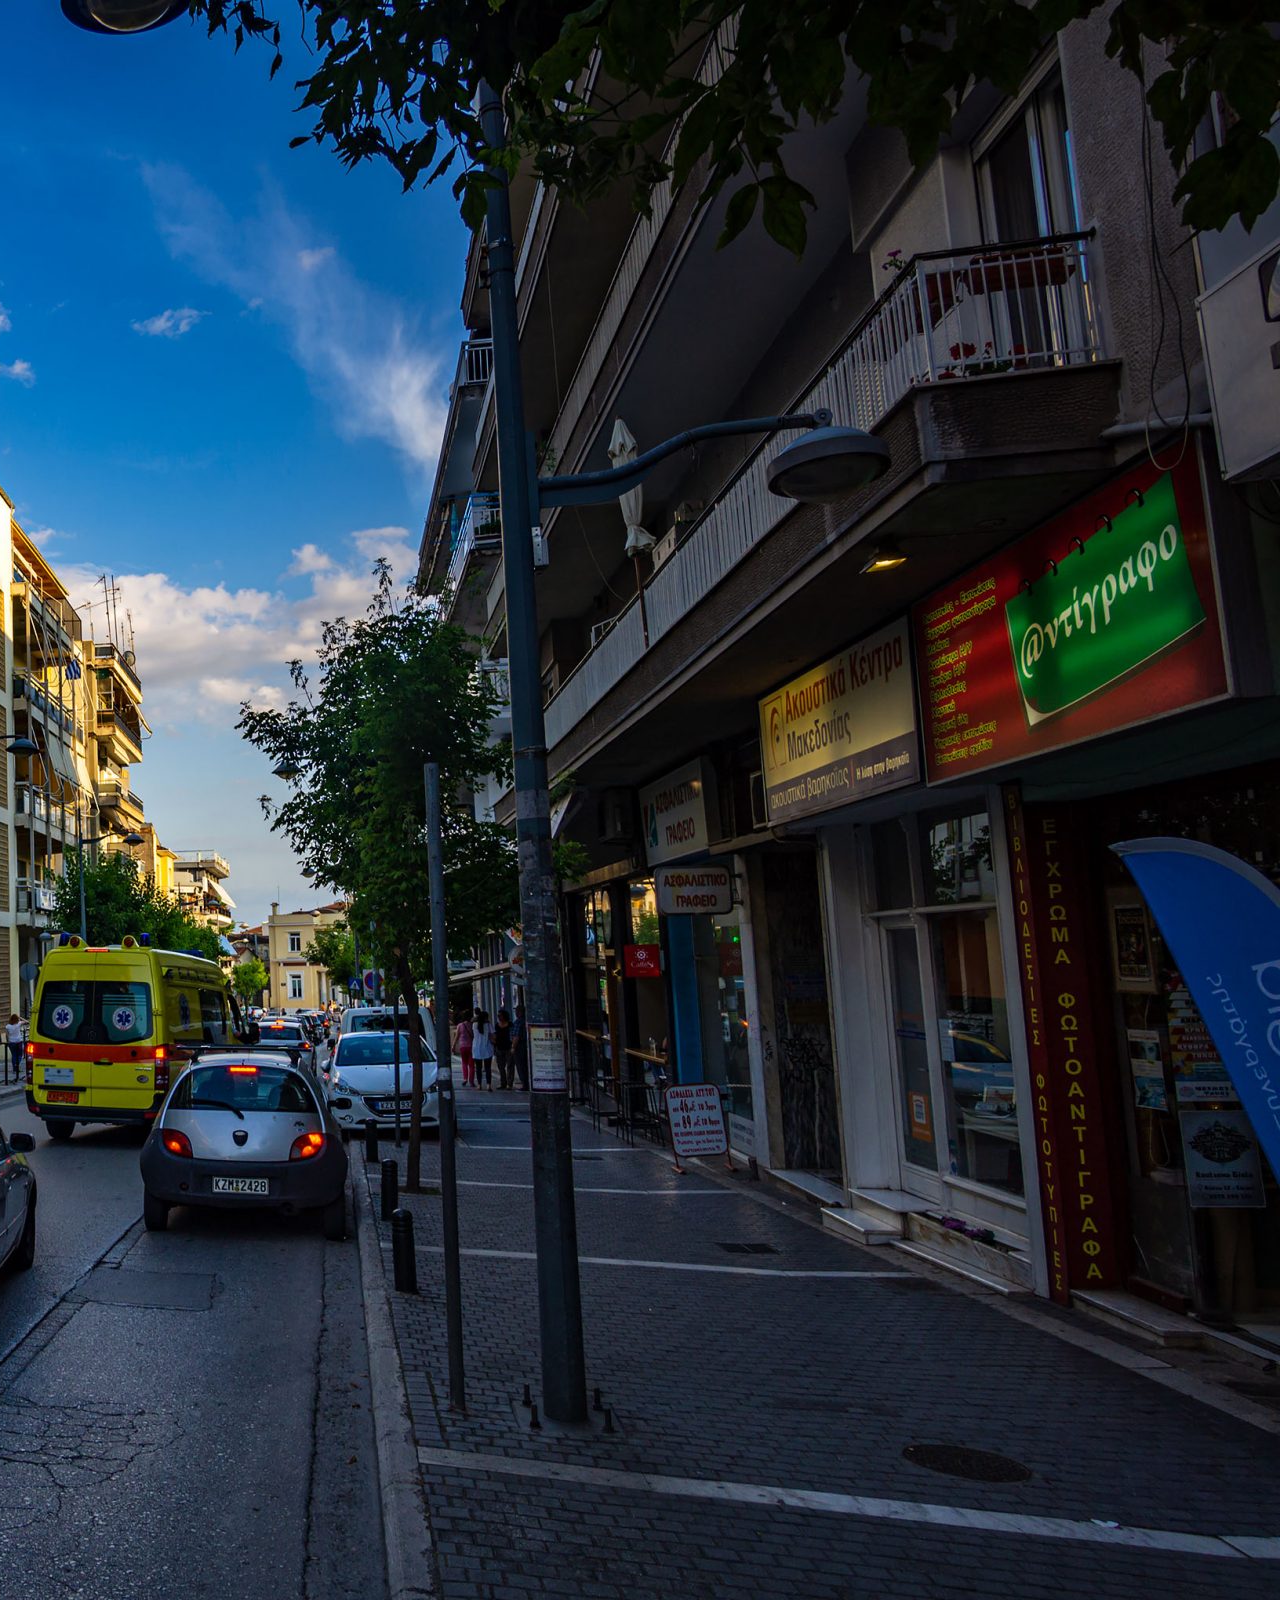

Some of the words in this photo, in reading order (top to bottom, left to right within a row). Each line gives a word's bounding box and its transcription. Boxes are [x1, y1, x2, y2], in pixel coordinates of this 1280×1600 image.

[785, 658, 846, 725] Ακουστικά
[849, 635, 903, 691] Κέντρα
[787, 709, 851, 762] Μακεδονίας
[665, 816, 695, 846] ΓΡΑΦΕΙΟ
[663, 873, 727, 888] ΑΣΦΑΛΙΣΤΙΚΟ
[676, 894, 717, 908] ΓΡΑΦΕΙΟ
[1007, 793, 1041, 1047] ΒΙΒΛΙΟΔΕΣΙΕΣ
[1035, 1072, 1064, 1292] ΦΩΤΟΤΥΠΙΕΣ
[1041, 818, 1071, 965] ΕΓΧΡΩΜΑ
[1057, 992, 1104, 1280] ΦΩΤΟΑΝΤΙΓΡΑΦΑ
